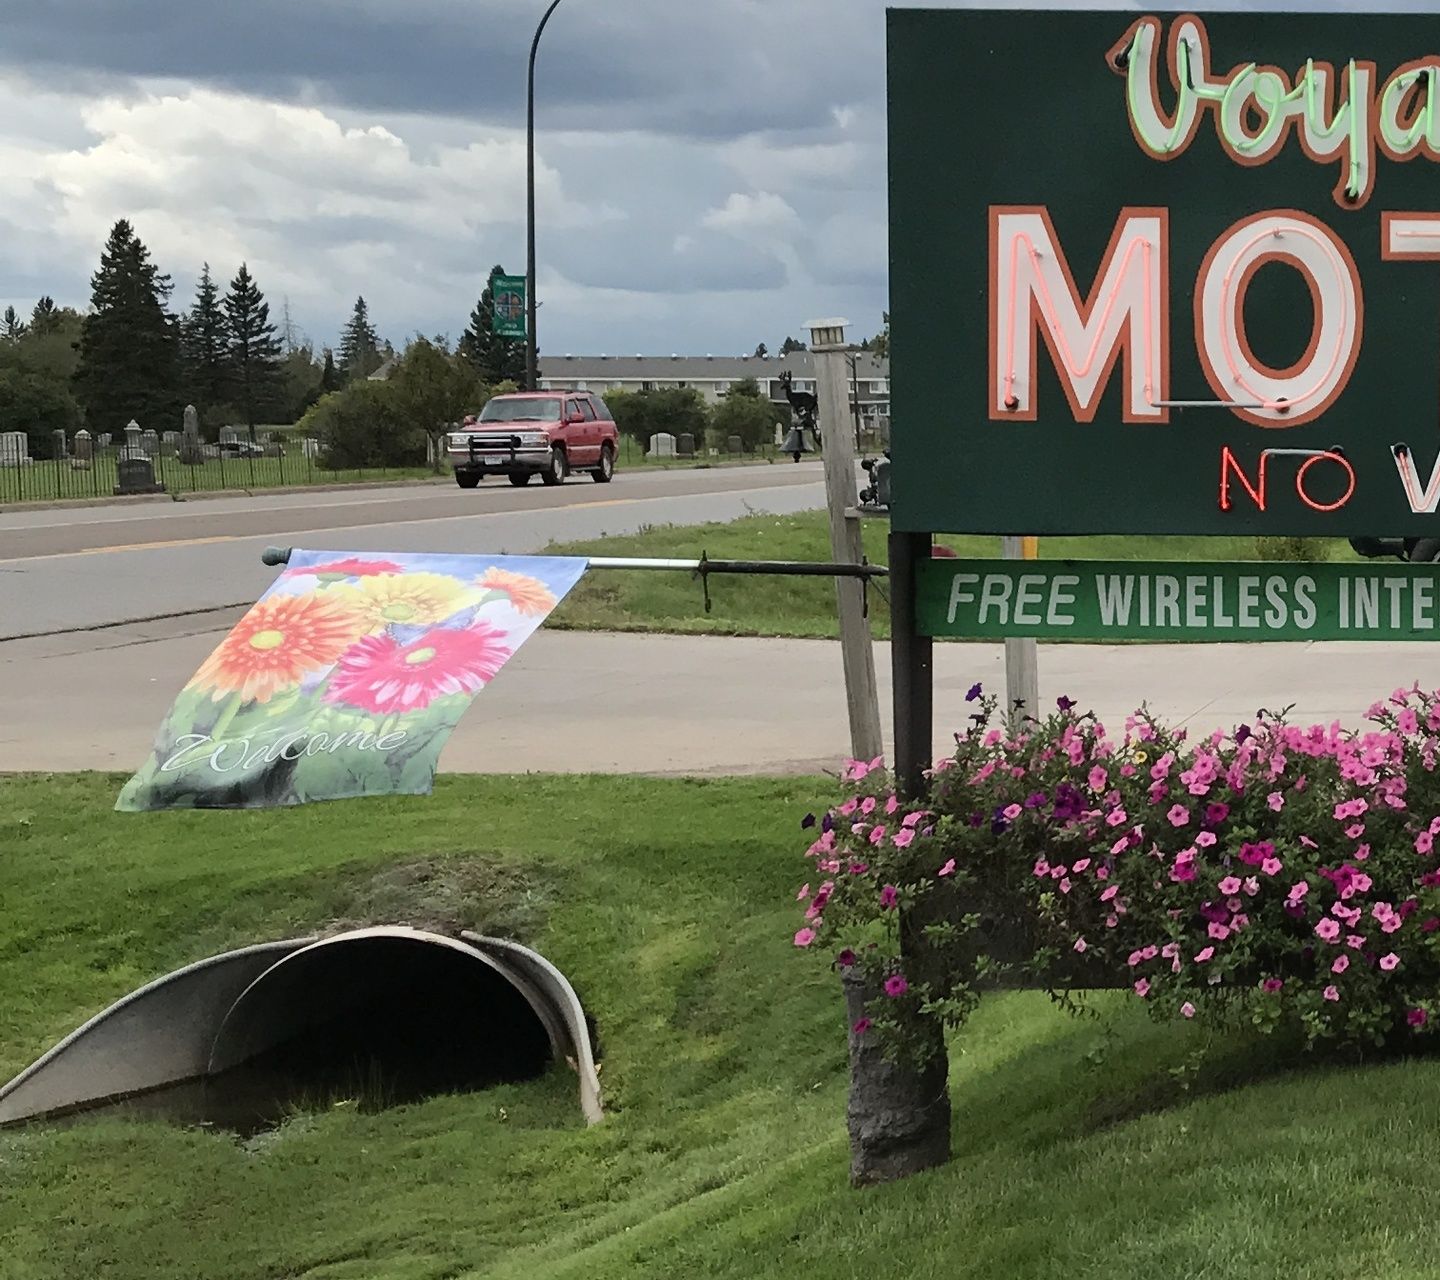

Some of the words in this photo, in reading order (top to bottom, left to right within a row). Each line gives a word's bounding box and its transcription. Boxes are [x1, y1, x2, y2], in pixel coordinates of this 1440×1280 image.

[1219, 445, 1356, 513] NO
[947, 574, 1080, 625] FREE
[1095, 575, 1317, 629] WIRELESS
[161, 727, 408, 772] Welcome
